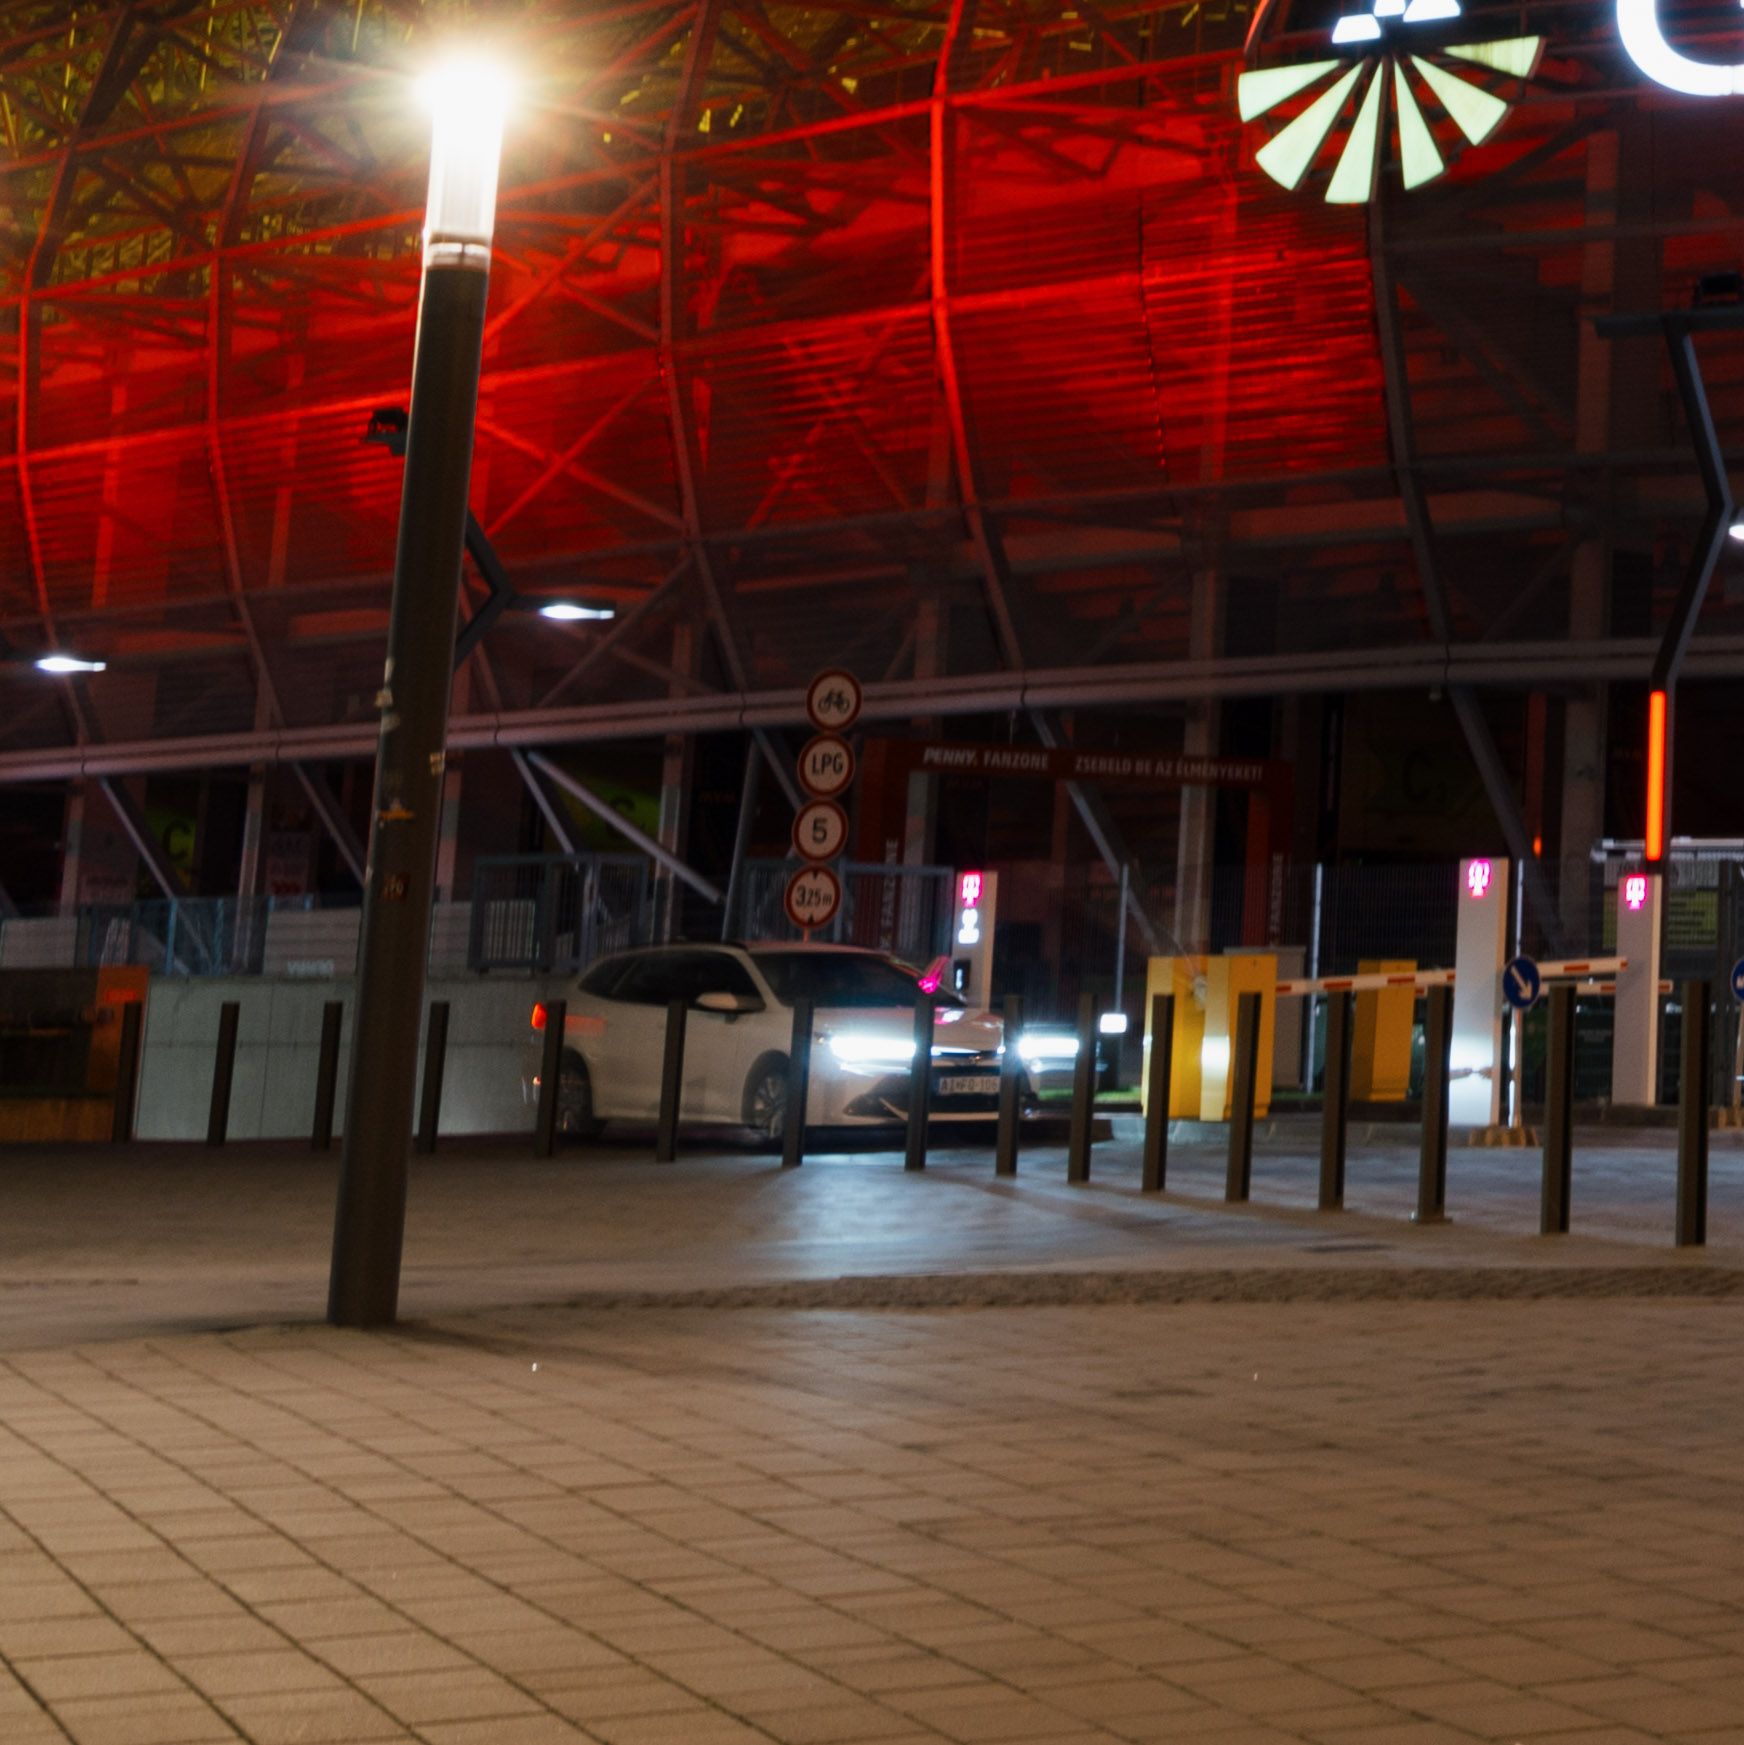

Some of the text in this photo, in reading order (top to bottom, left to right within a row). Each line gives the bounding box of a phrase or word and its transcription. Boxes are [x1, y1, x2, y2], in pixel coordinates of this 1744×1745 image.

[811, 752, 844, 775] LPG
[983, 749, 1050, 771] FANZONE
[1074, 755, 1131, 774] ZSEBELD
[1135, 758, 1152, 775] BE
[1155, 759, 1173, 776] AZ
[811, 817, 828, 844] 5
